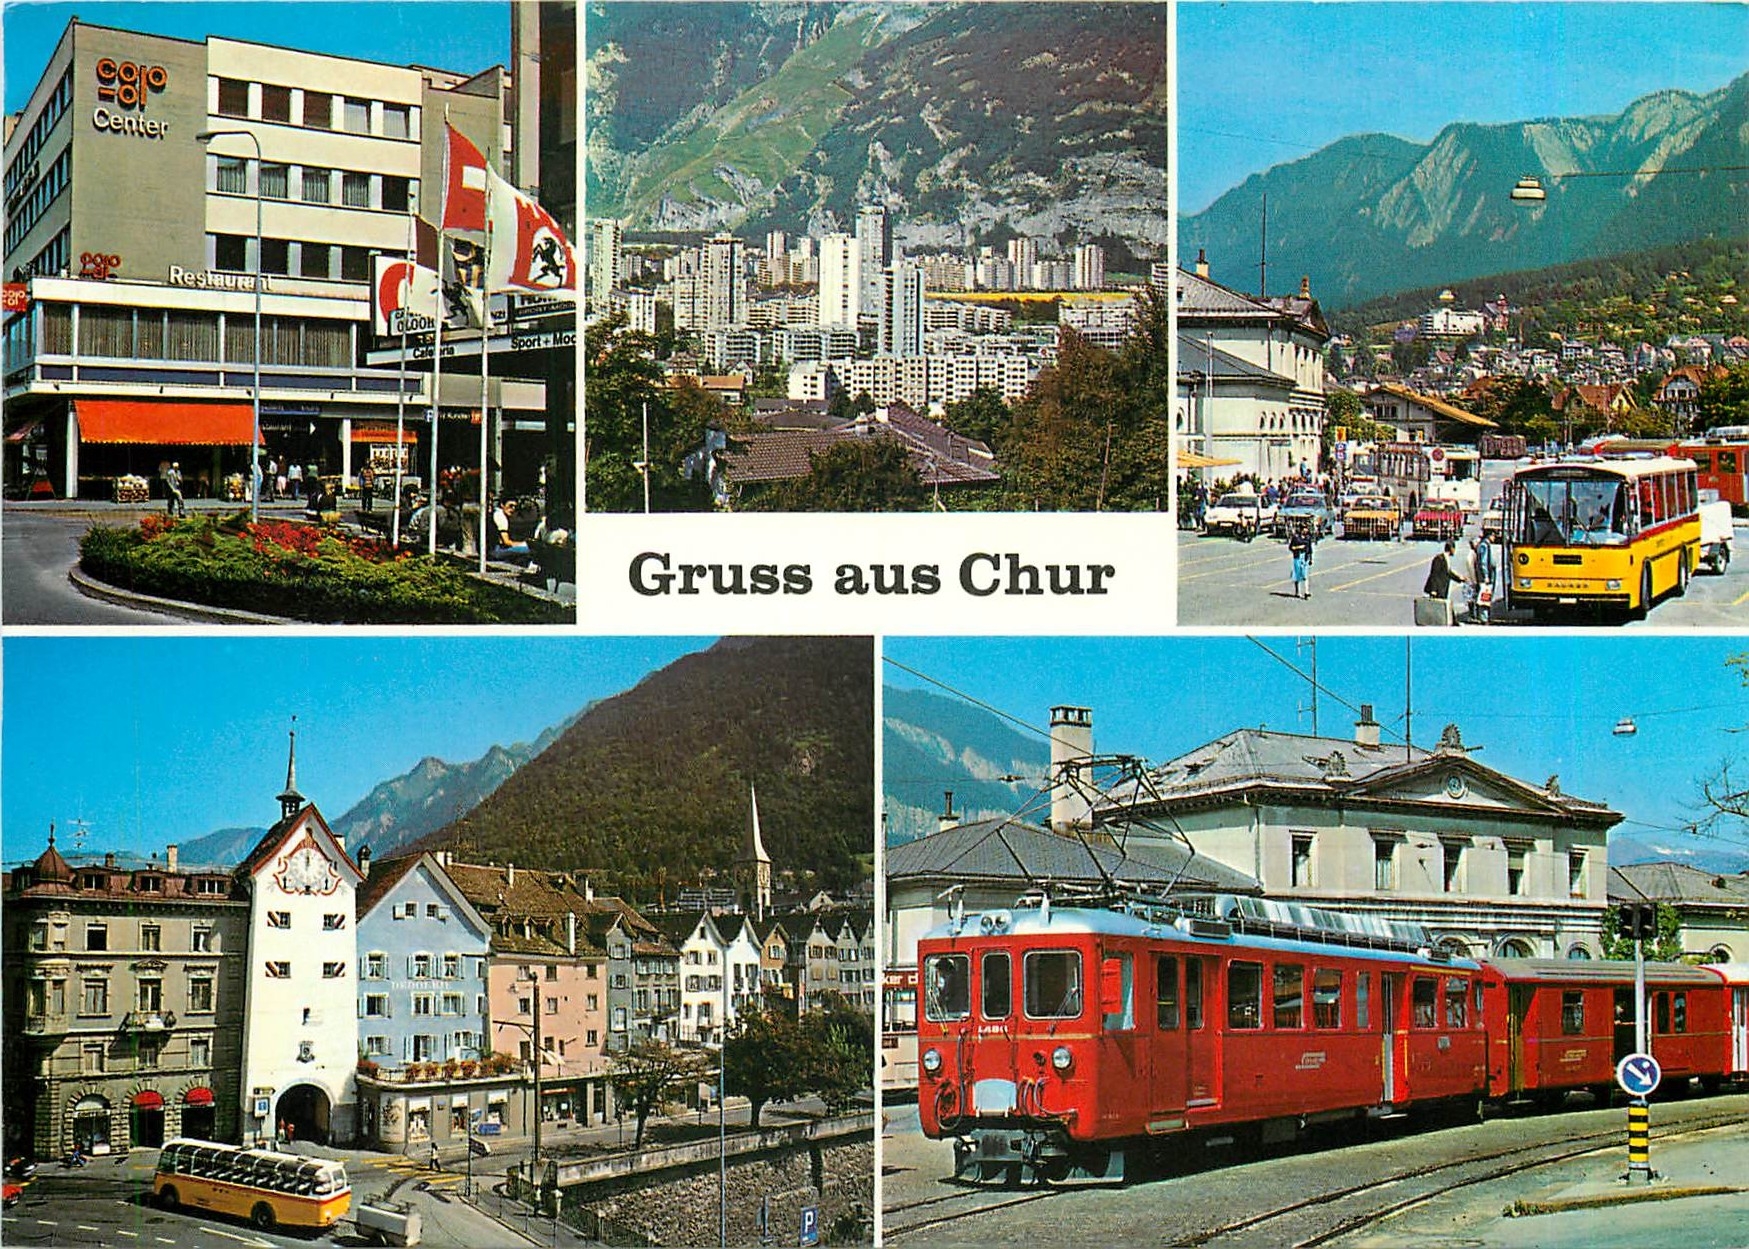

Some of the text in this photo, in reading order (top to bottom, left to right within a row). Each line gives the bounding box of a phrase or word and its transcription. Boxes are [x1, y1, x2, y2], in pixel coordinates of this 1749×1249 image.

[94, 108, 169, 136] Center
[169, 265, 272, 290] Restaurant
[511, 334, 541, 351] Sport
[805, 1211, 814, 1233] P
